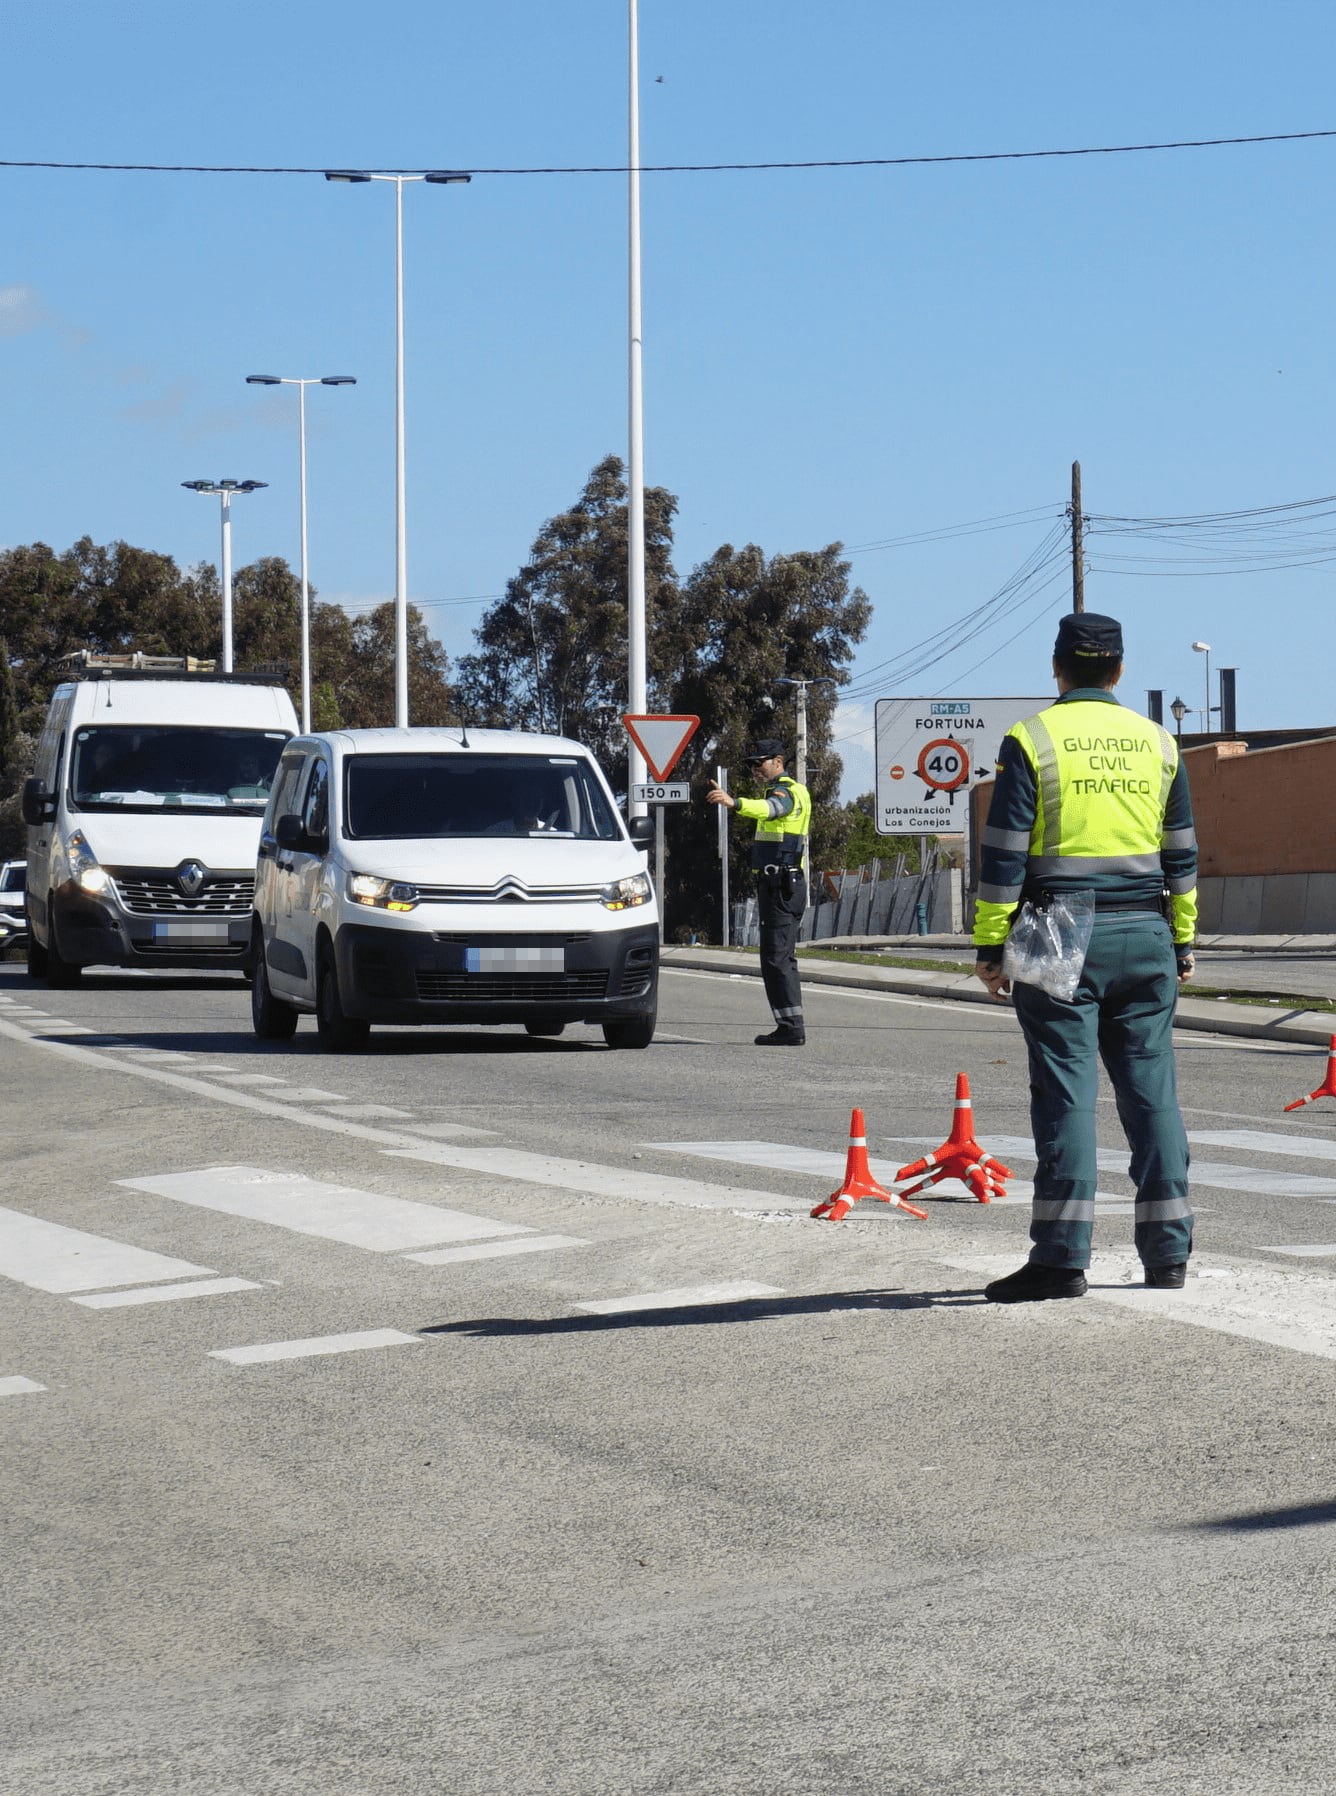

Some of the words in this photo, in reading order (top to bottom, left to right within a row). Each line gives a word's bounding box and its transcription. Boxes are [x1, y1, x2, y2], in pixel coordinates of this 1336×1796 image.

[931, 704, 969, 714] RM-A5
[915, 718, 985, 729] FORTUNA
[1063, 736, 1152, 752] GUARDIA
[928, 755, 959, 773] 40
[1089, 755, 1132, 771] CIVIL
[640, 787, 665, 799] 150
[670, 790, 681, 799] m
[885, 805, 951, 815] urbanización
[885, 818, 903, 827] Los
[909, 818, 951, 828] Conejos
